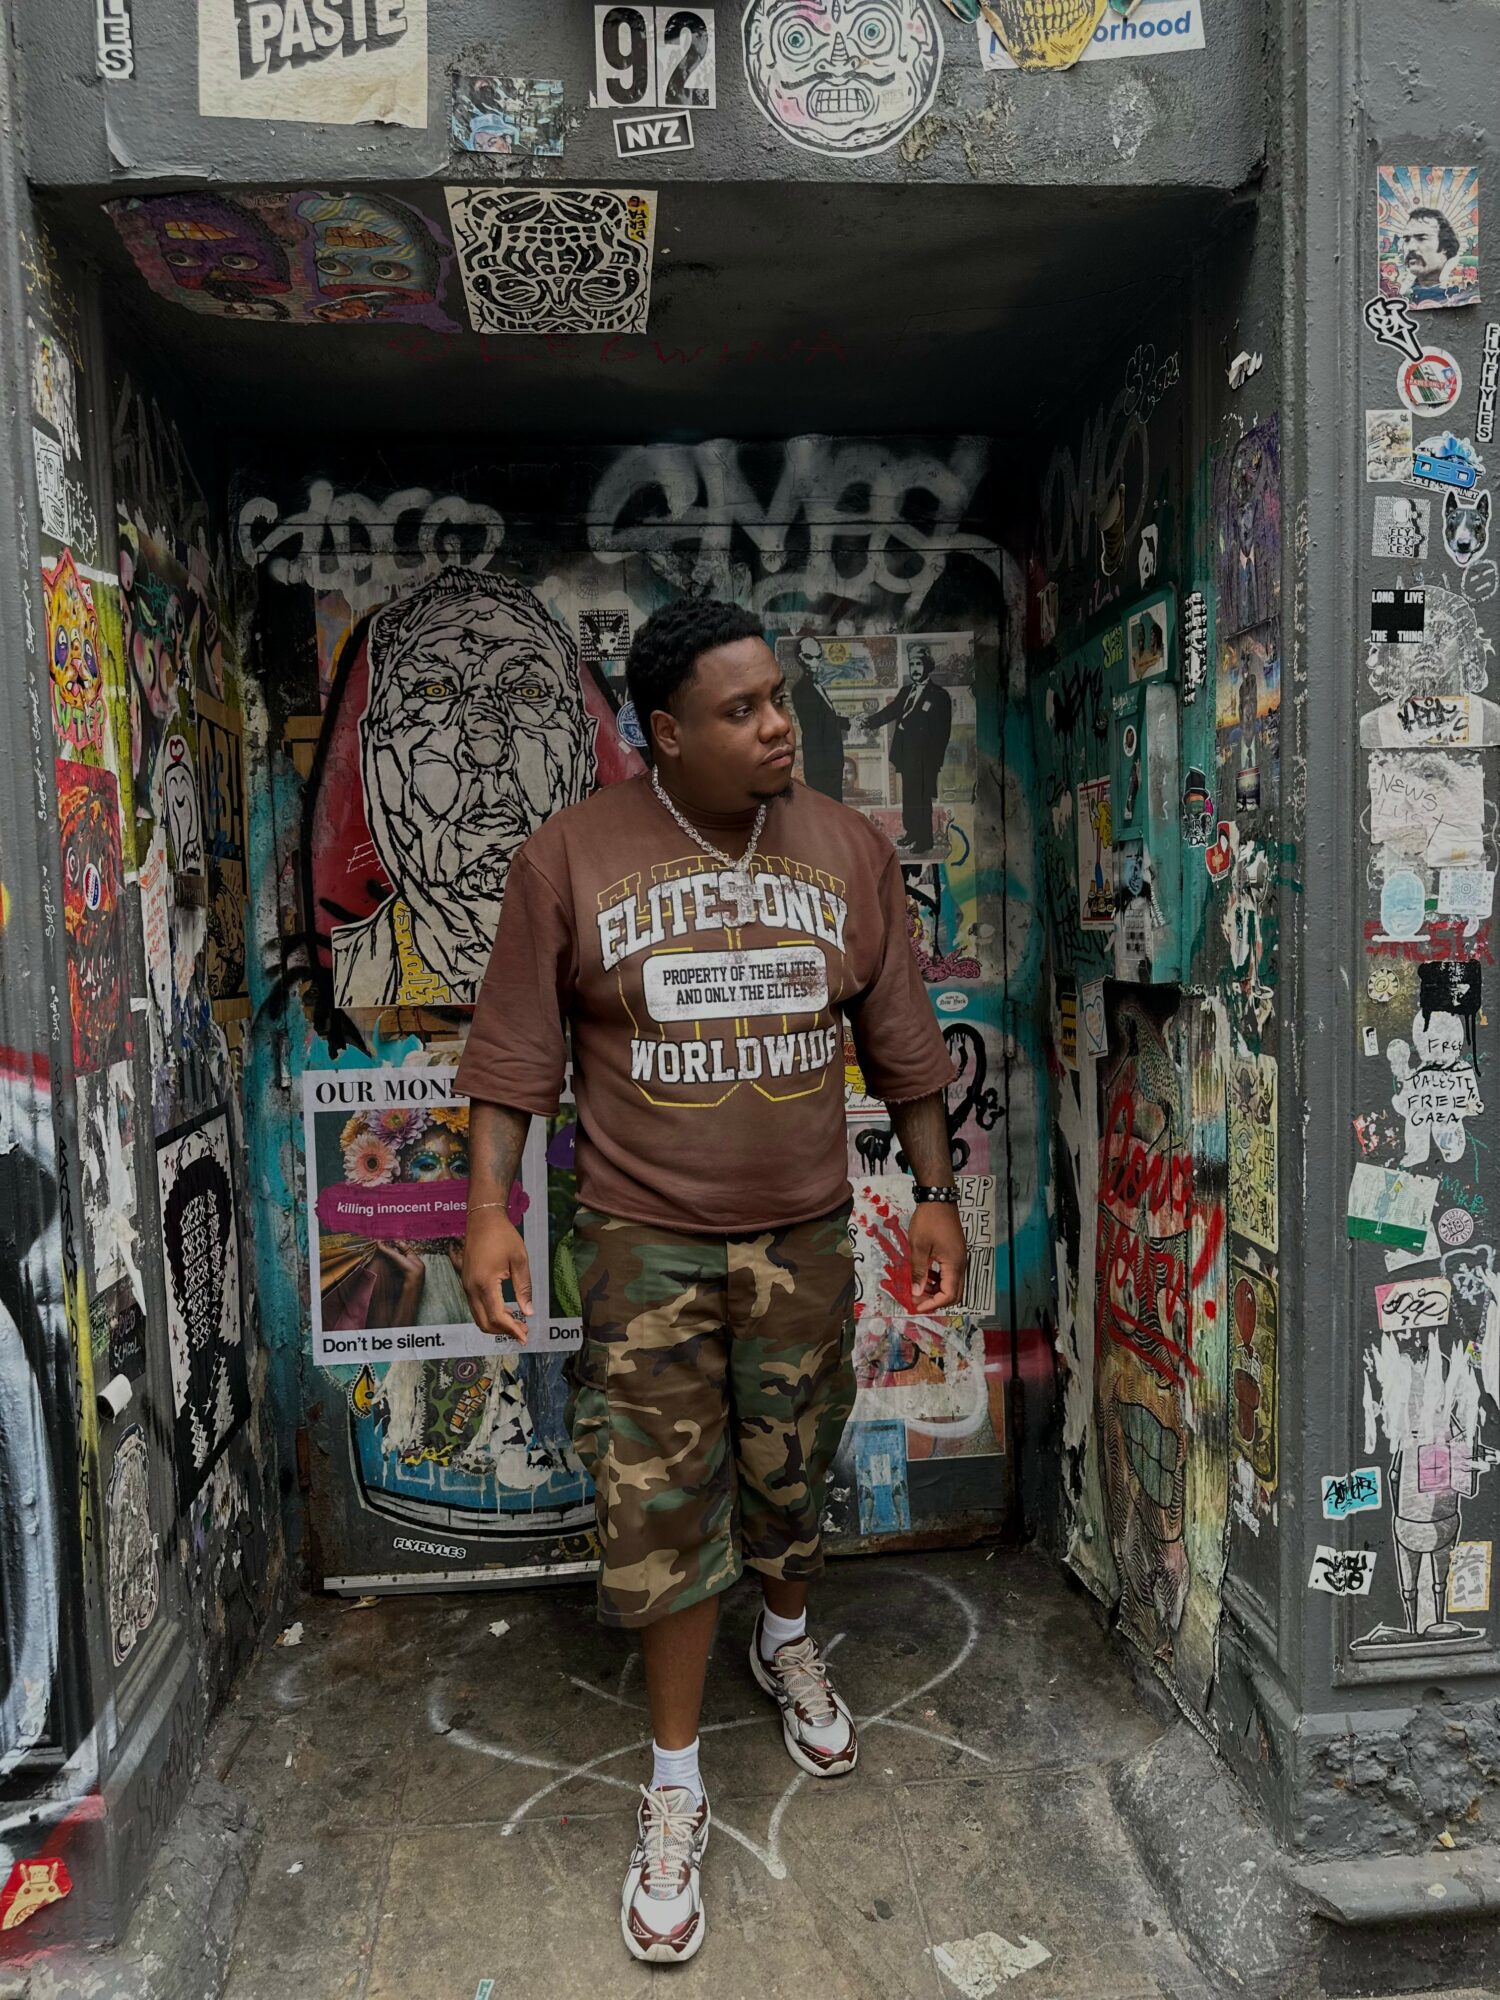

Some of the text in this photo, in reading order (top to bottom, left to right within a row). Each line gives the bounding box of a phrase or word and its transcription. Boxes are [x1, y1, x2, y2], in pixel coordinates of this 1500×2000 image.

[626, 120, 682, 149] NYZ
[1389, 536, 1411, 545] FLY
[1390, 528, 1411, 536] FLY
[1389, 546, 1411, 555] LES
[1372, 591, 1424, 603] LONG LIVE
[1371, 630, 1423, 642] THE THING
[1378, 773, 1438, 812] NEWS
[597, 871, 848, 973] ELITES ONLY
[663, 961, 818, 986] PROPERTY OF THE ELITES
[676, 982, 808, 1006] AND ONLY THE ELITES
[1428, 1039, 1464, 1054] FREE
[315, 1081, 376, 1105] OUR
[1407, 1095, 1467, 1109] FREE
[1410, 1113, 1460, 1127] GAZA
[336, 1199, 468, 1217] killing innocent Pales
[323, 1332, 446, 1353] Don't be silent.
[394, 1537, 467, 1559] FLYFLYLES
